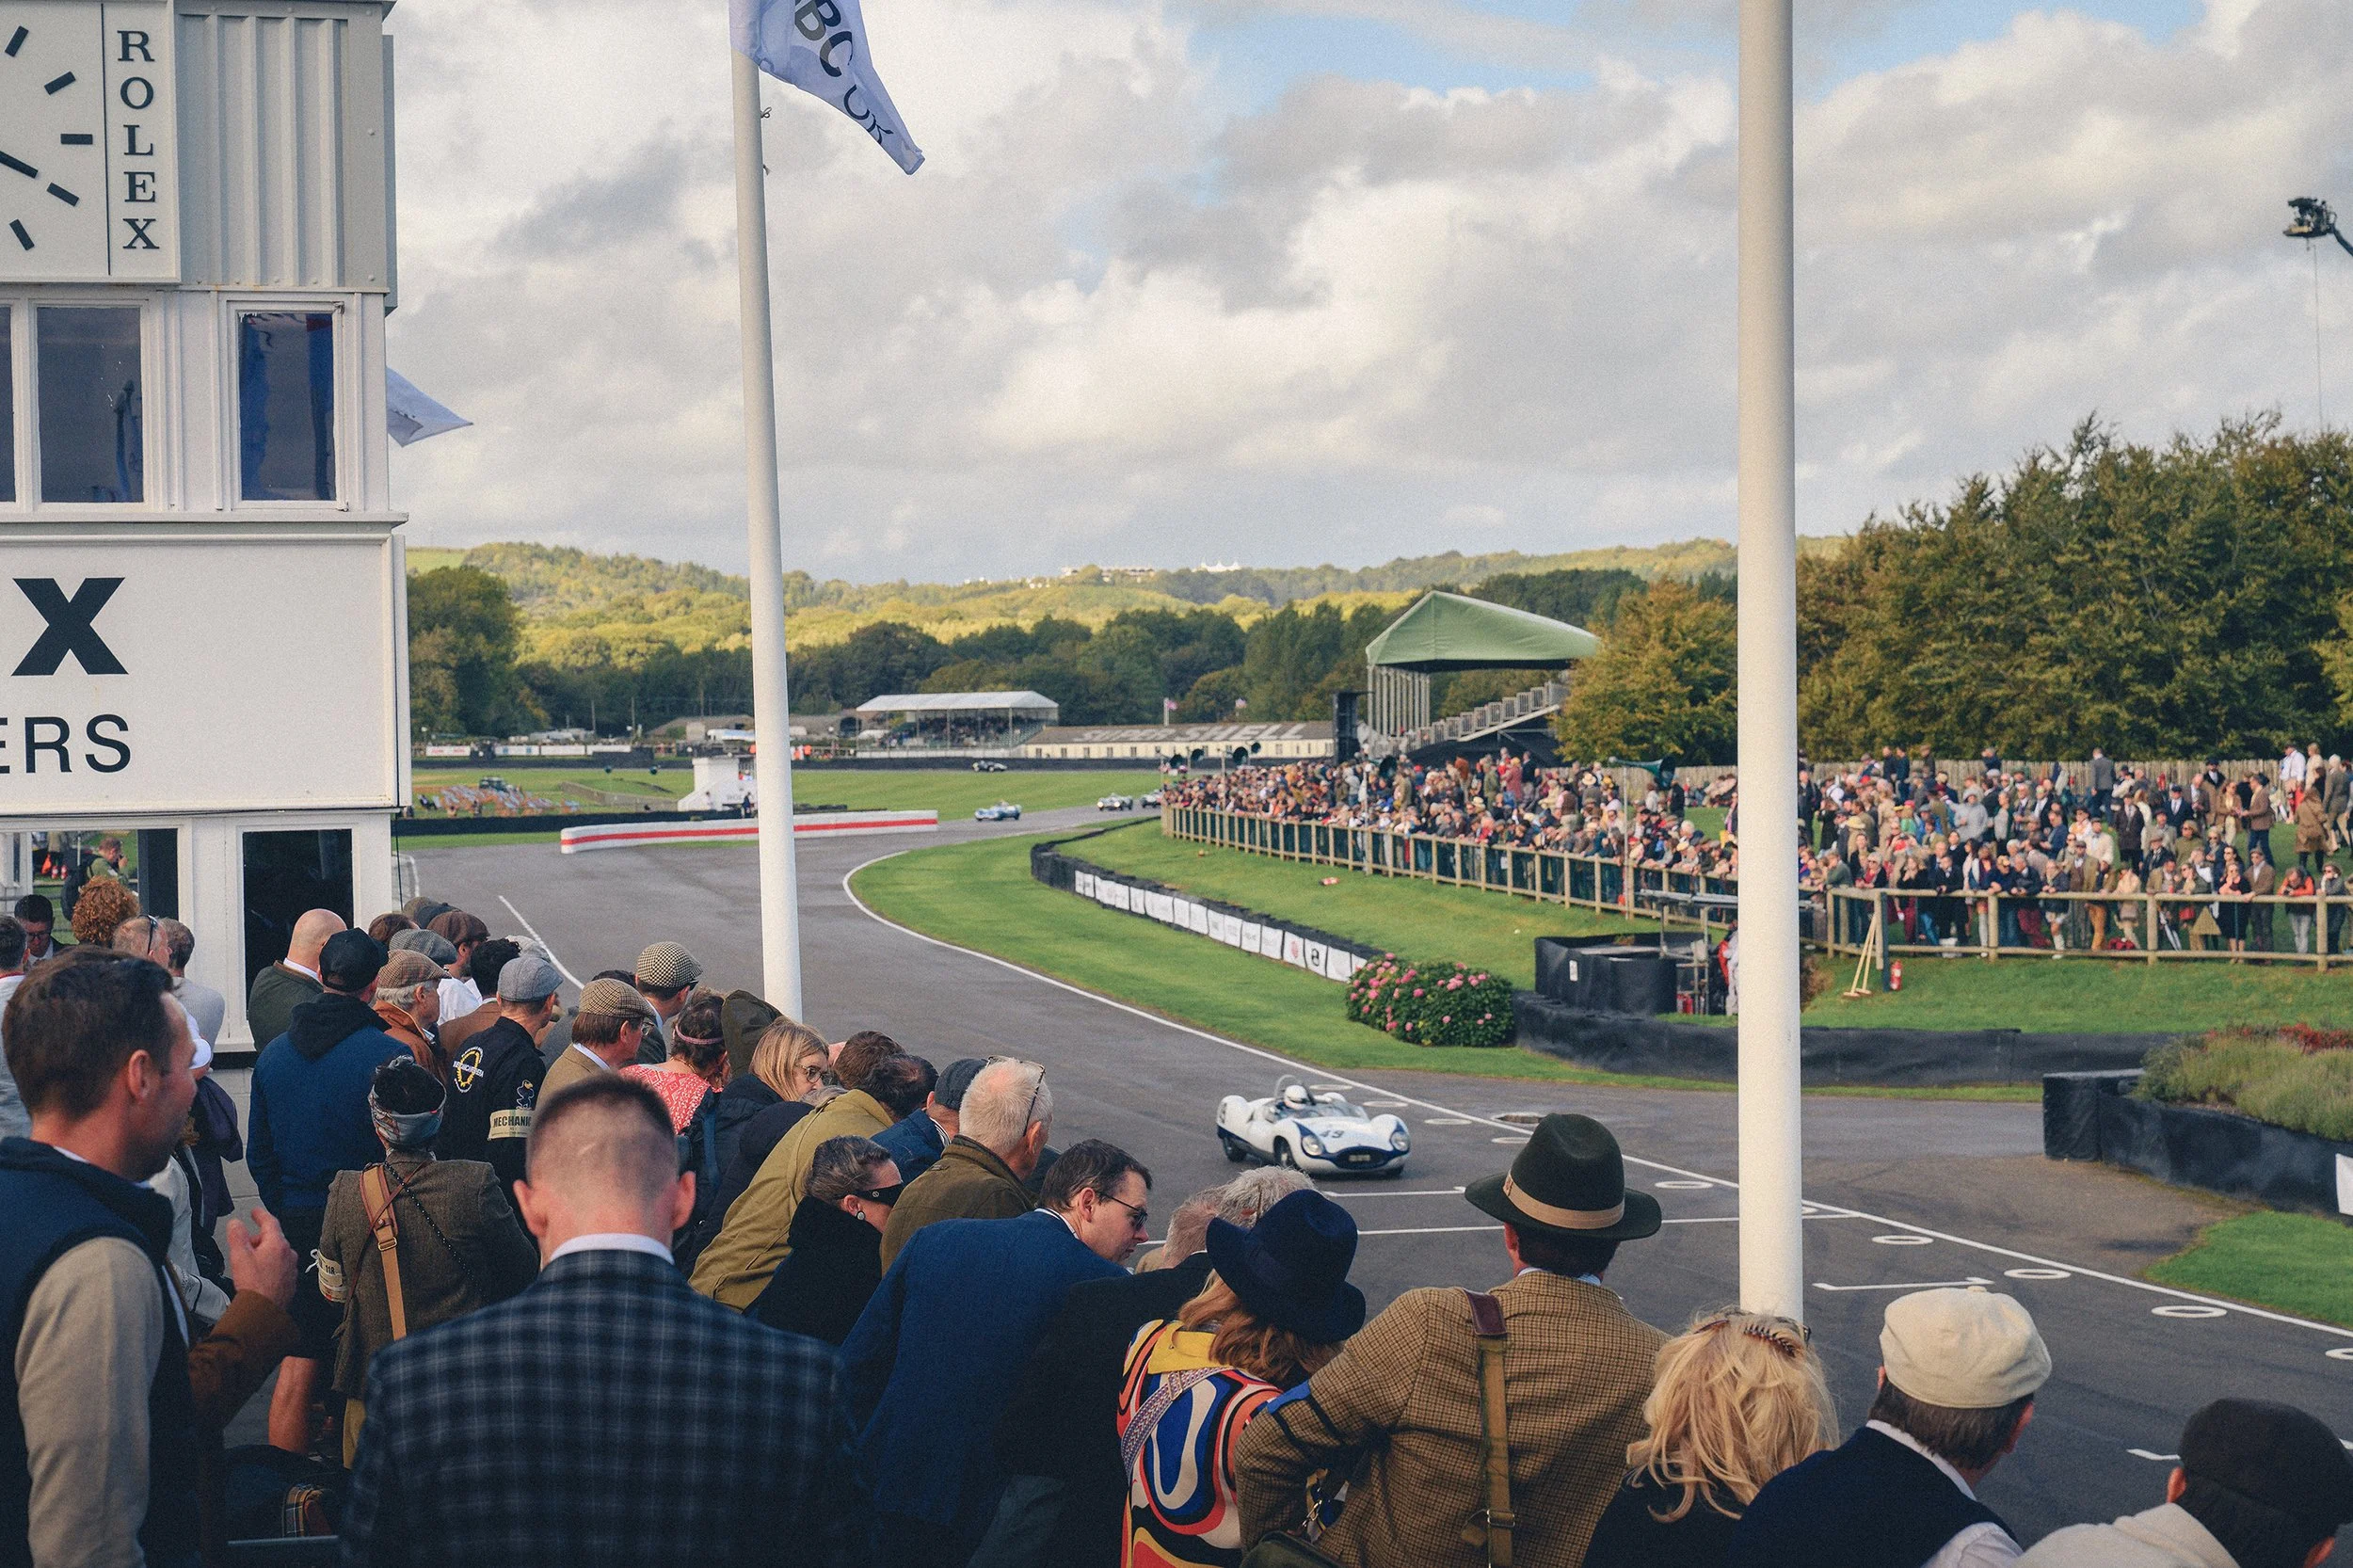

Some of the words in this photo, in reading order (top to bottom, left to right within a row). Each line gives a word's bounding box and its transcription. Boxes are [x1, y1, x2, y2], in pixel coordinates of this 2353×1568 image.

[117, 30, 160, 249] ROLEX
[0, 713, 131, 774] RS
[1173, 723, 1305, 741] SHELL
